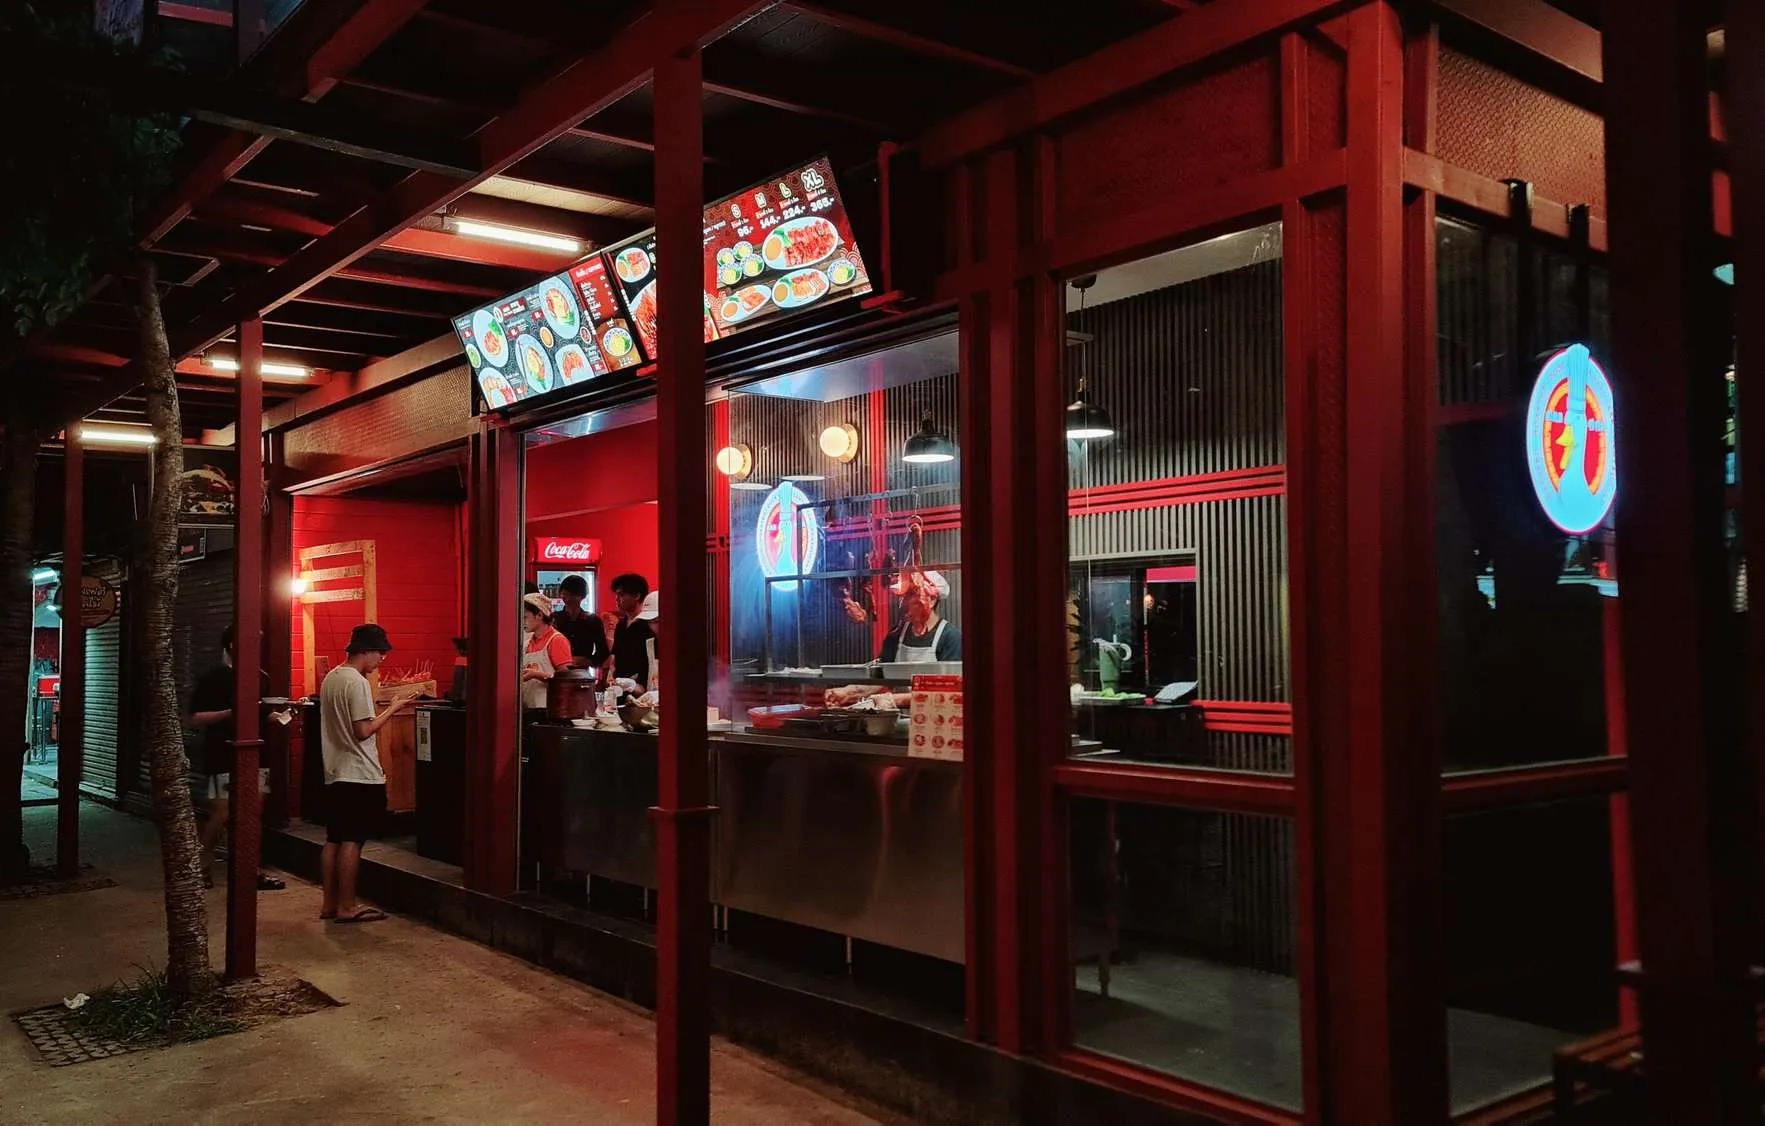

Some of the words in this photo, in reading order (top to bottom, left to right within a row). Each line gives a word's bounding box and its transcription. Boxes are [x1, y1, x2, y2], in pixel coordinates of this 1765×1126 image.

[779, 182, 792, 198] L
[801, 168, 824, 192] XL
[783, 205, 805, 220] 224.-
[544, 541, 592, 559] Coca-Cola
